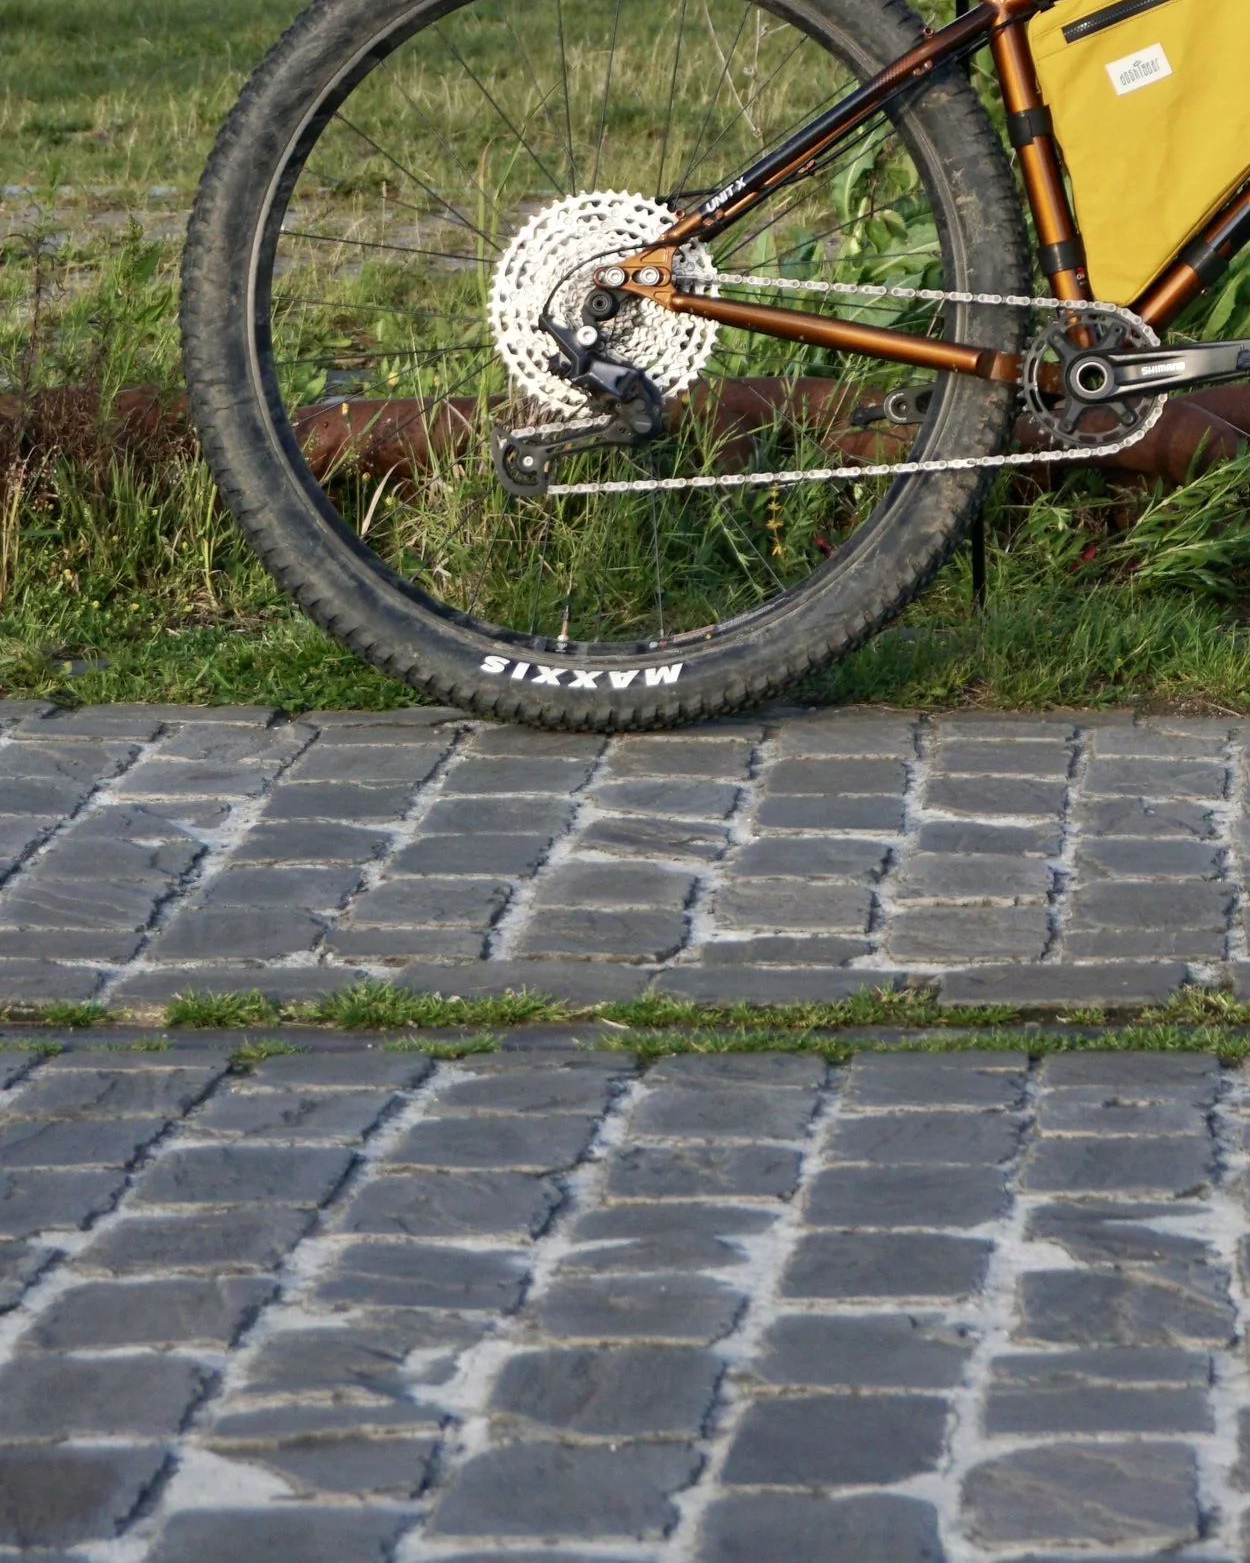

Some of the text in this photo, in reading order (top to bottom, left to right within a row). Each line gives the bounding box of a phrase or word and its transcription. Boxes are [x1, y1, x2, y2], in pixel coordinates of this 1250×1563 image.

[705, 177, 746, 213] UNIT X
[1141, 362, 1185, 375] SHIMANO
[480, 655, 683, 689] MAXXIS
